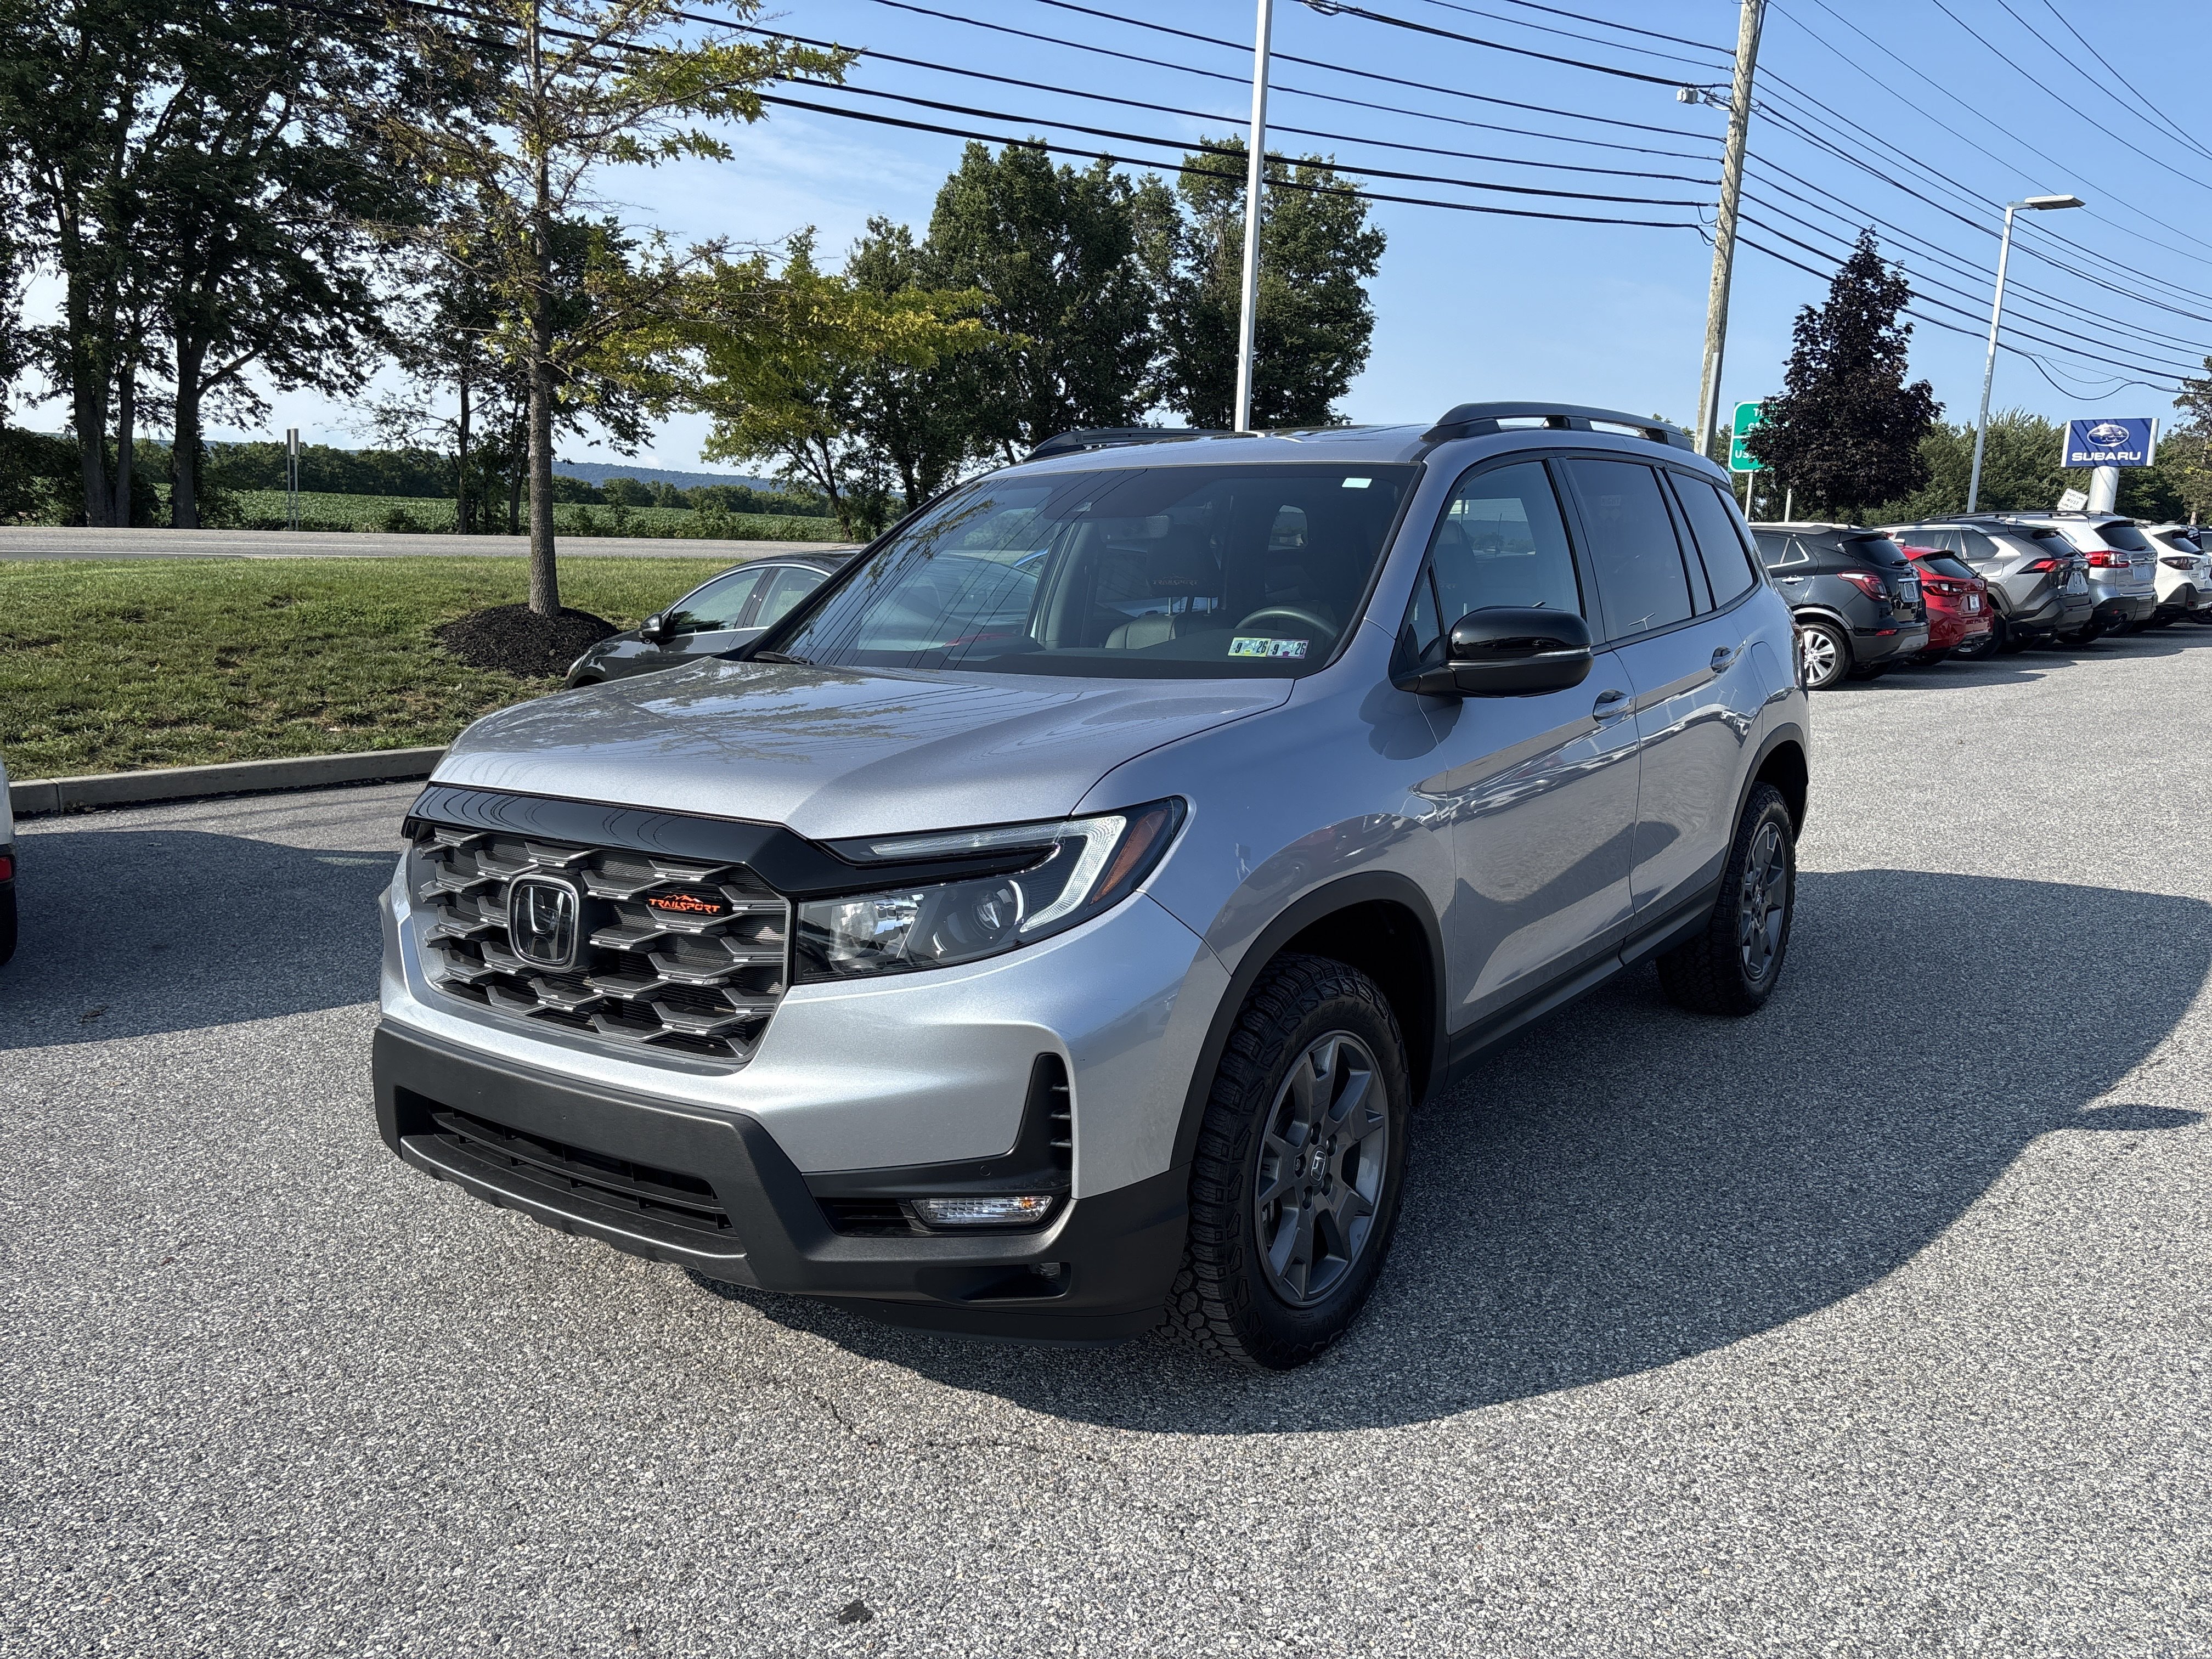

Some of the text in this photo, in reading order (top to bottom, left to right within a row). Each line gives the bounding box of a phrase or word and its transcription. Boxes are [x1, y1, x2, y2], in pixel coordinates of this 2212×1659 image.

[2072, 452, 2141, 461] SUBARU
[1234, 641, 1268, 653] 9 26
[1272, 642, 1306, 655] 9 26
[648, 898, 721, 914] TRAILSPORT
